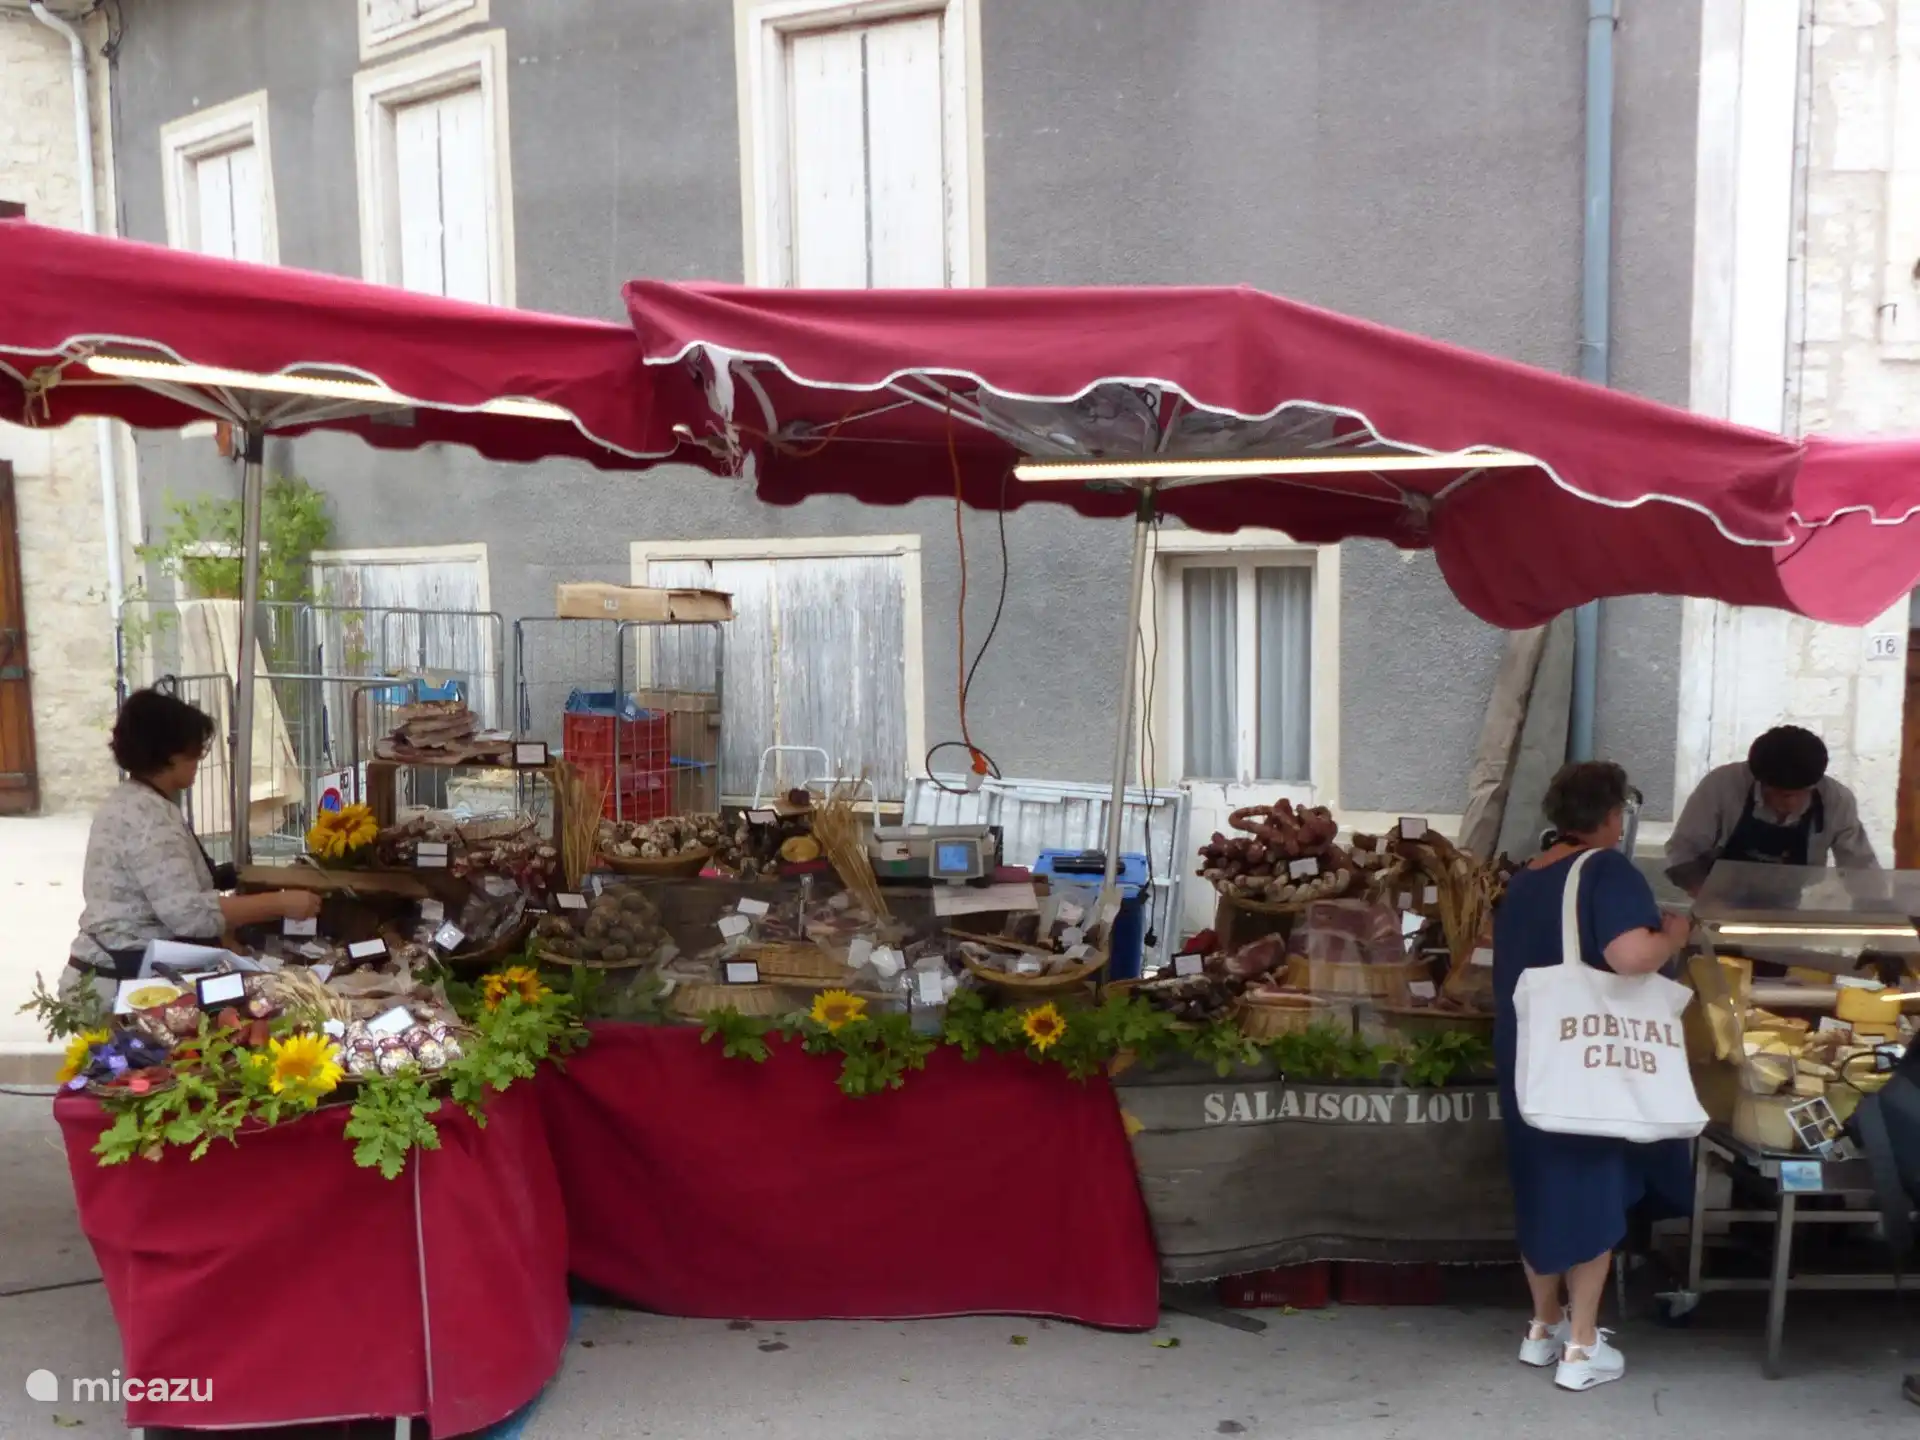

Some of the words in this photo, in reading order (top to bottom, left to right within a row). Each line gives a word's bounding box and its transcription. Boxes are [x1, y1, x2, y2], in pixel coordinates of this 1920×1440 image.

[1875, 638, 1896, 654] 16
[1583, 1044, 1657, 1074] CLUB
[1204, 1091, 1395, 1124] SALAISON
[1403, 1093, 1474, 1124] LOU
